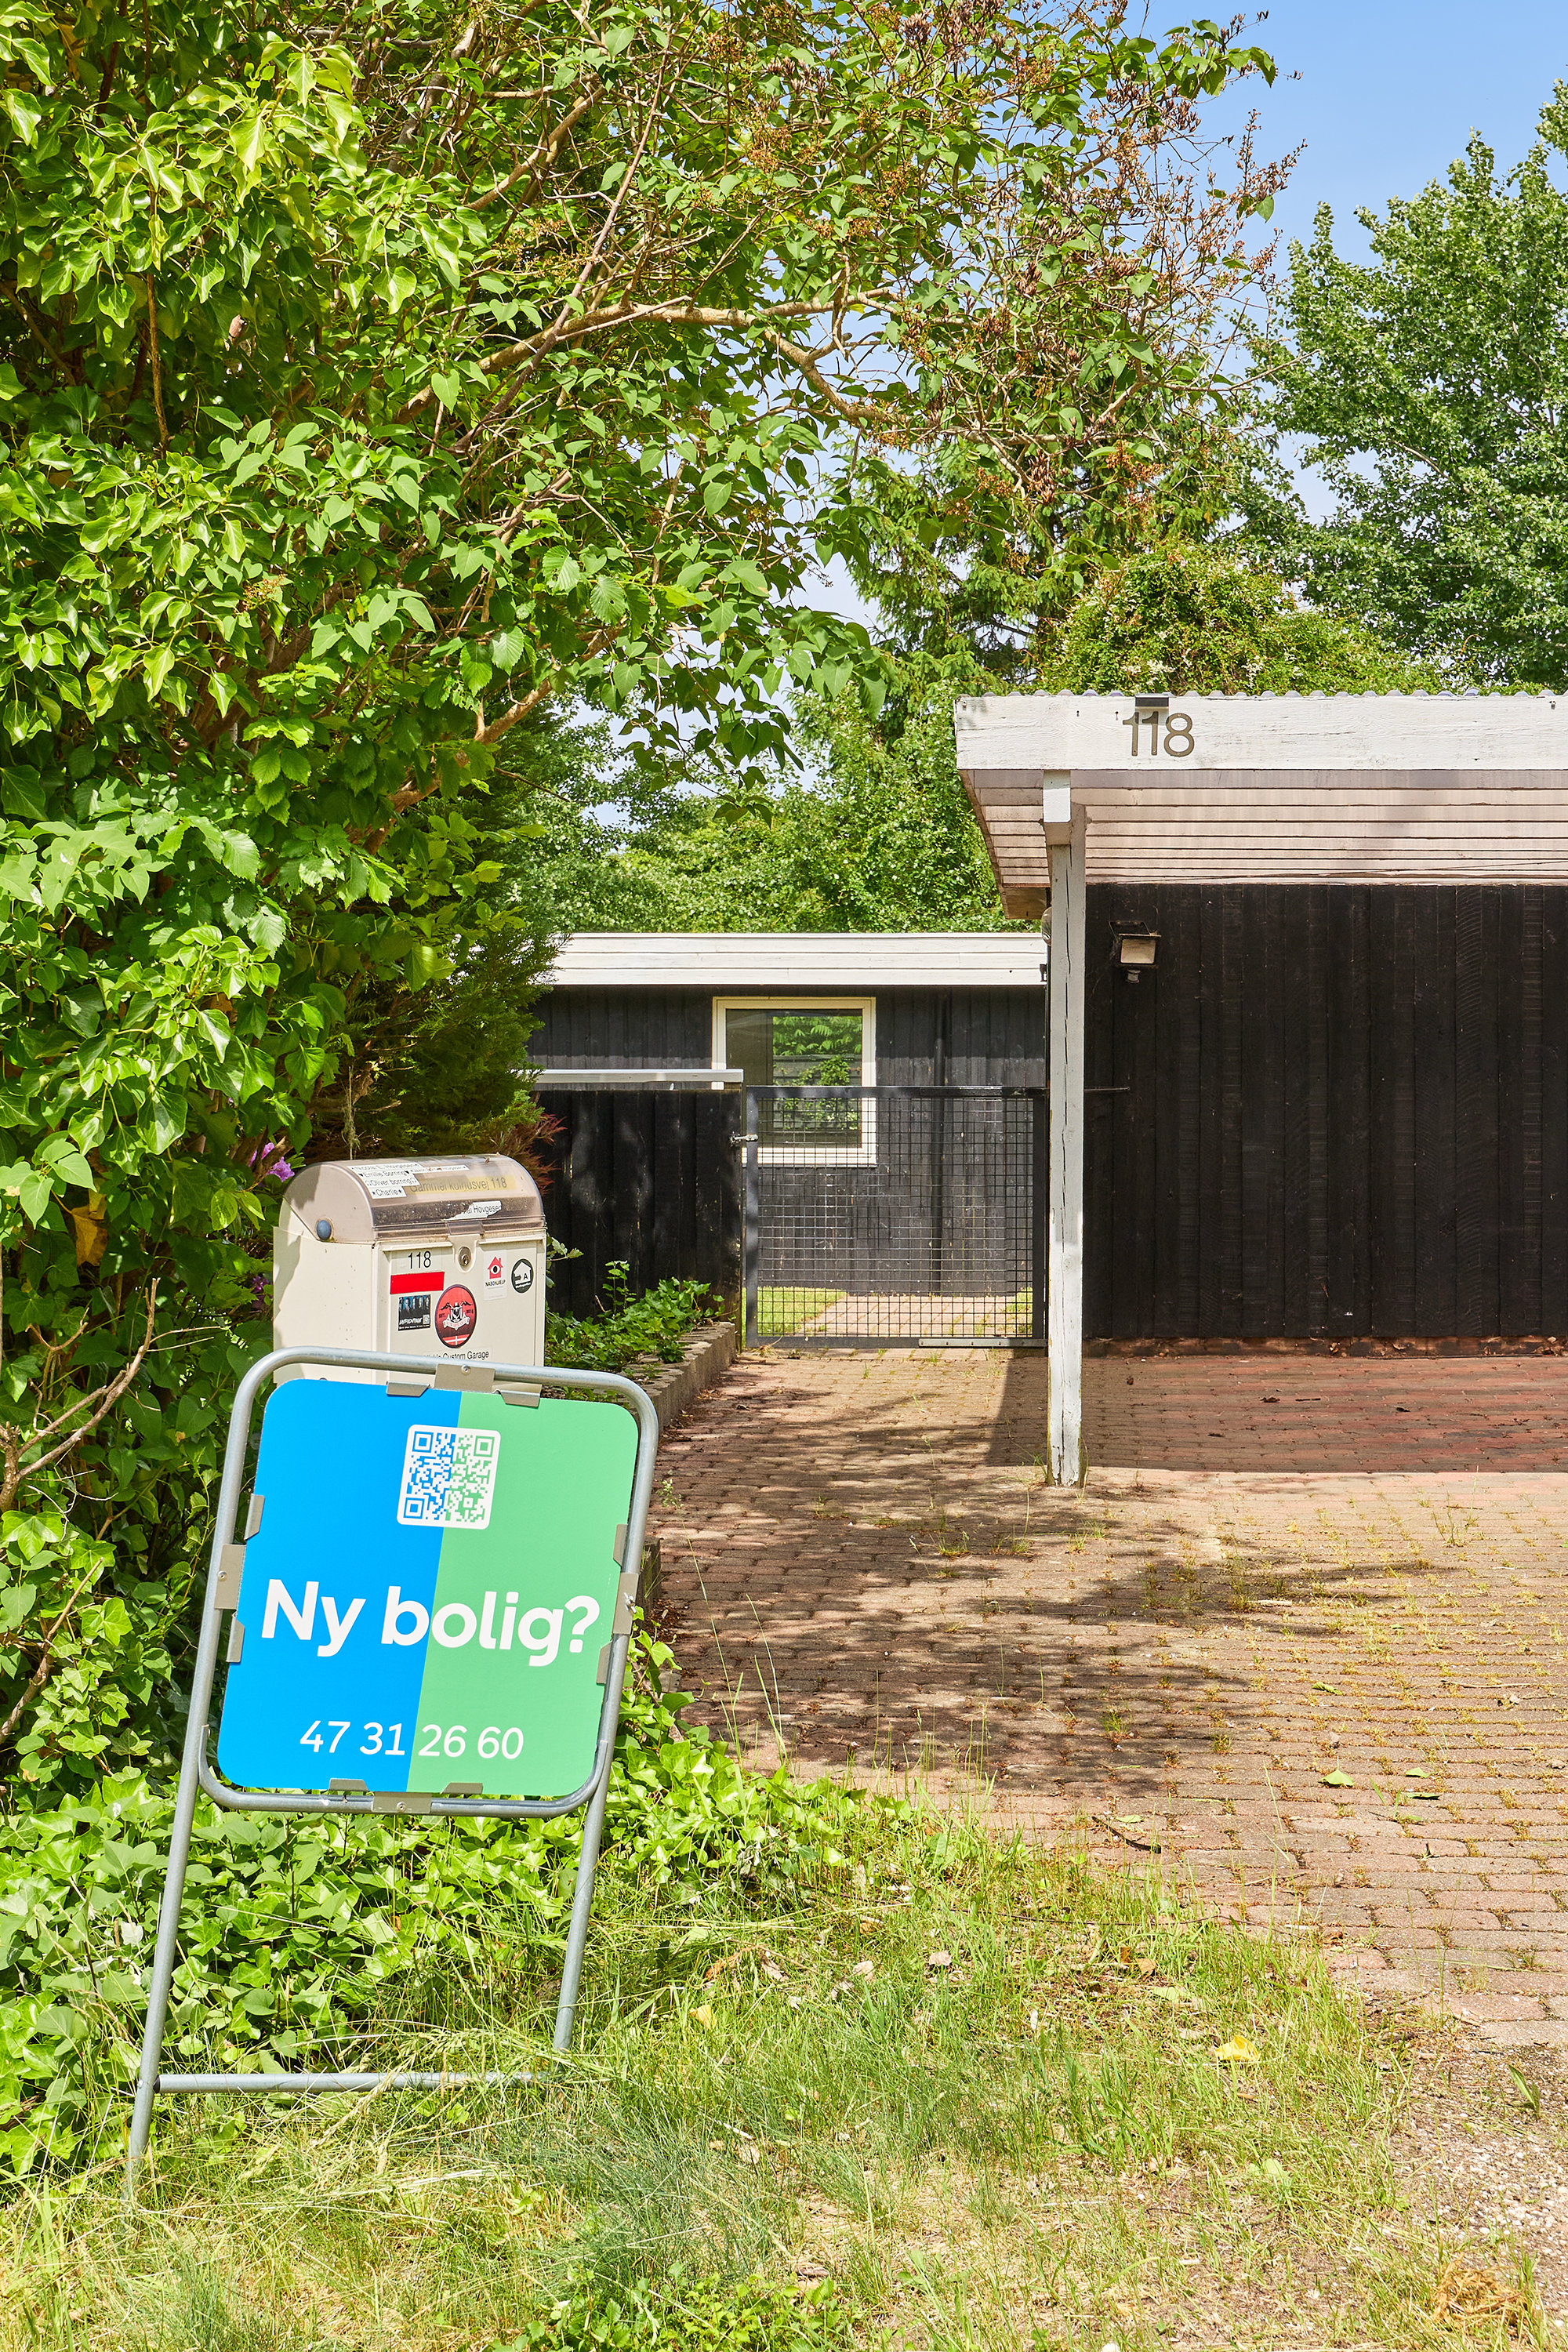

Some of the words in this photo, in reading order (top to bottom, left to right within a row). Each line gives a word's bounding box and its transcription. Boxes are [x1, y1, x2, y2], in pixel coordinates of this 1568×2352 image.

[1122, 711, 1195, 757] 118
[369, 1178, 389, 1187] Oliver
[491, 1177, 507, 1189] 118
[408, 1250, 431, 1269] 118
[467, 1350, 489, 1360] Garage
[261, 1578, 366, 1657] Ny
[381, 1585, 601, 1668] bolig?
[299, 1720, 351, 1754] 47
[360, 1722, 405, 1755] 31
[418, 1724, 468, 1758] 26
[477, 1726, 524, 1760] 60
